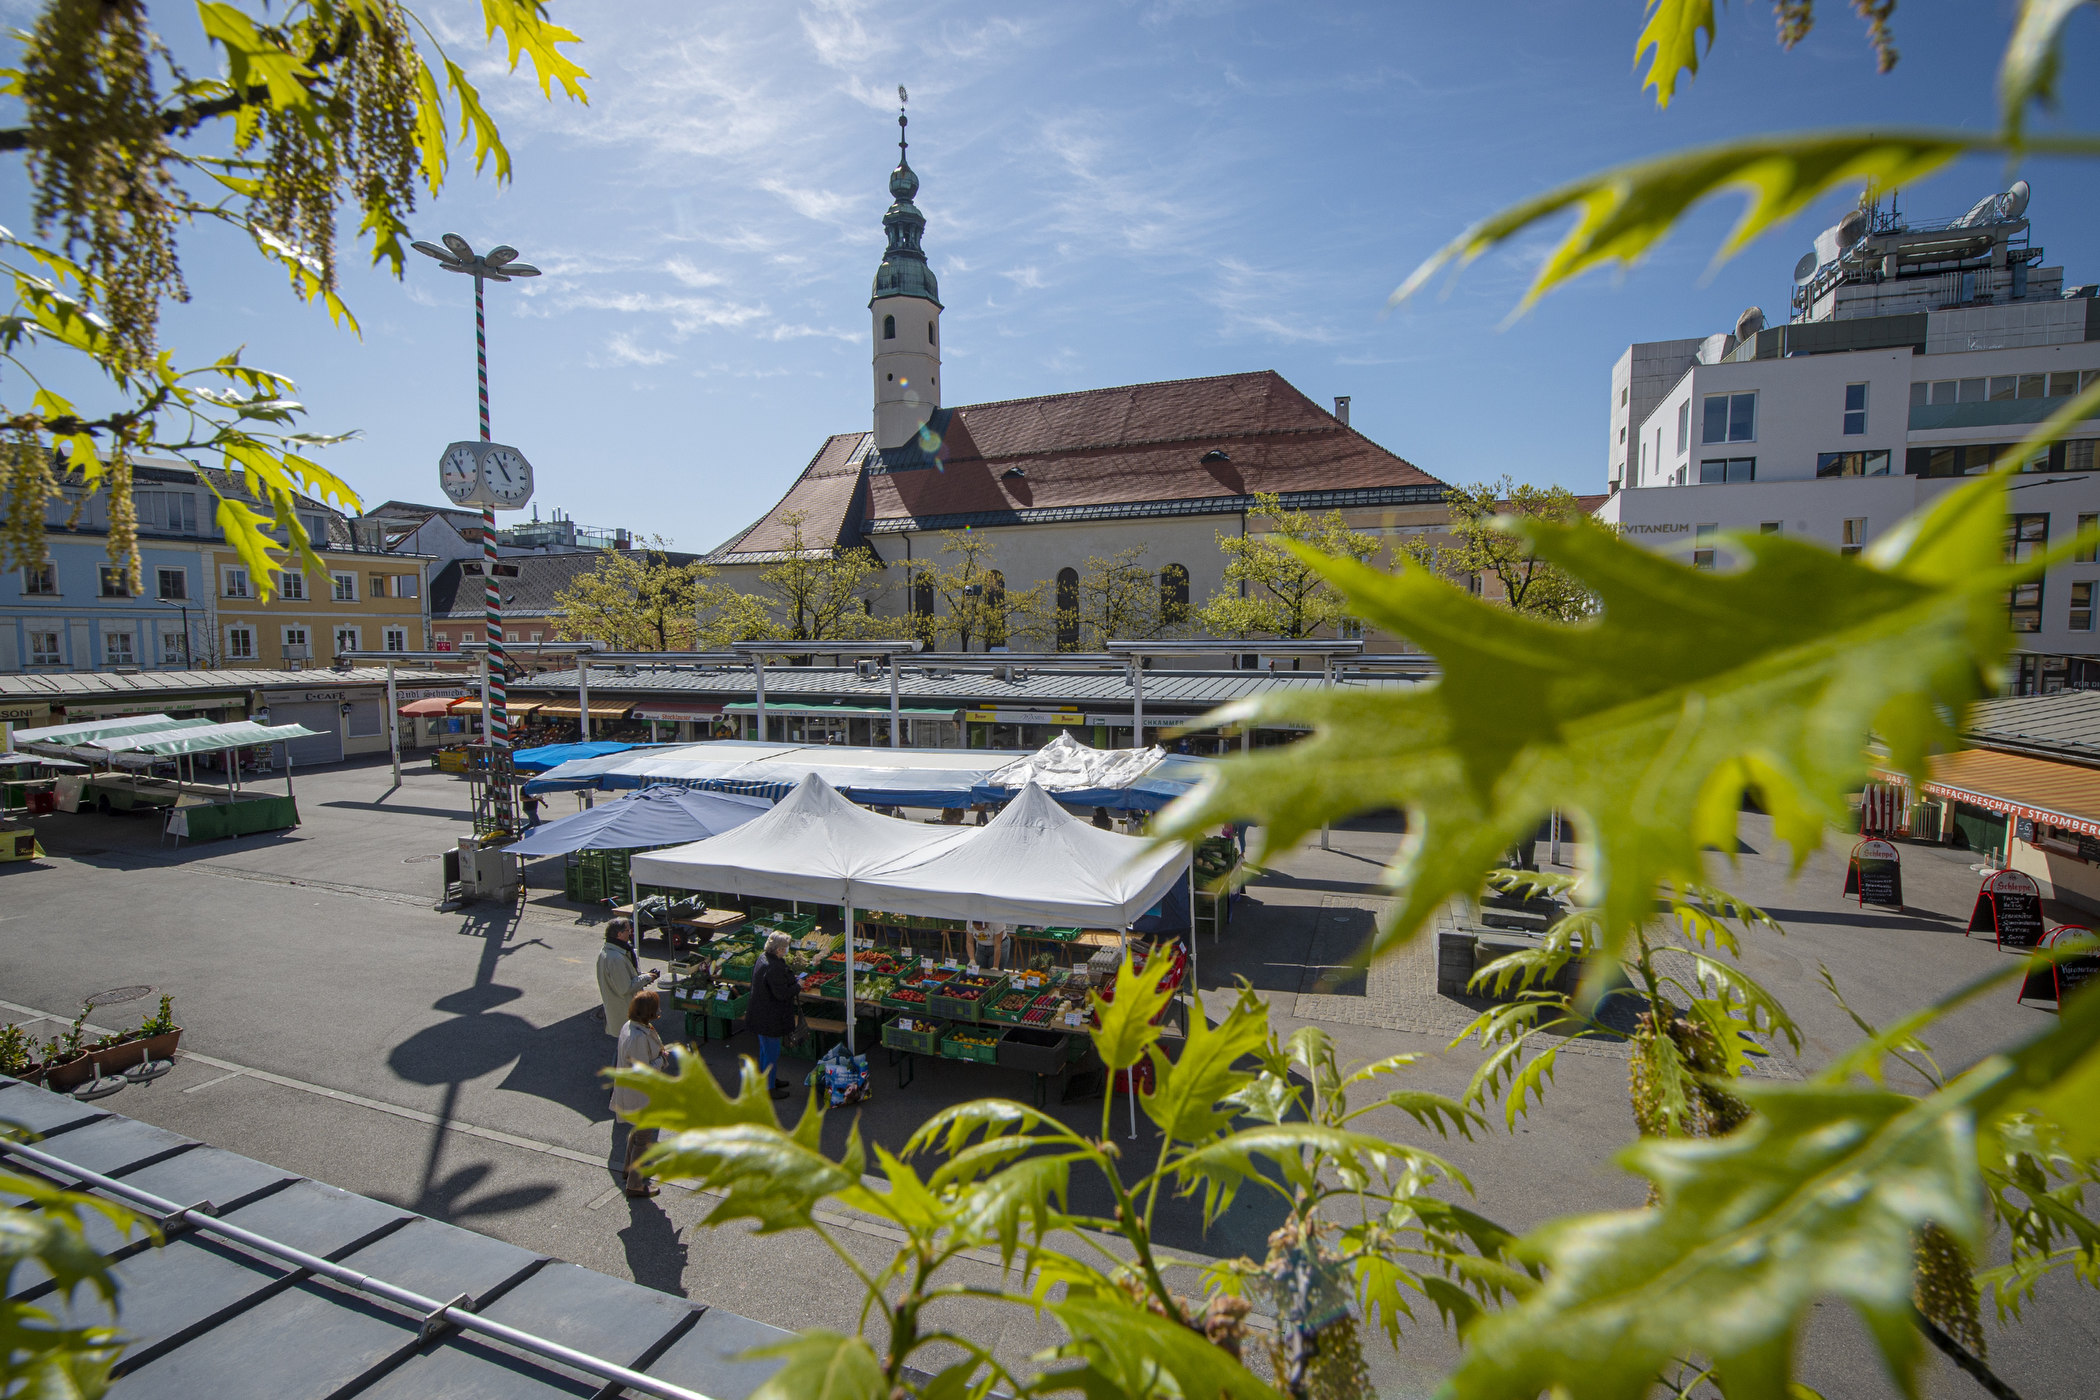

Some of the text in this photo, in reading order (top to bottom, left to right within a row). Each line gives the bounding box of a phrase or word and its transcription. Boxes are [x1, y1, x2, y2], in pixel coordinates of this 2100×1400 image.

[1625, 523, 1689, 534] VITANEUM
[423, 689, 464, 698] Schmiede
[1131, 719, 1184, 727] SCHKAMMER
[1886, 774, 1902, 784] DAS
[1996, 880, 2032, 893] Schleppe
